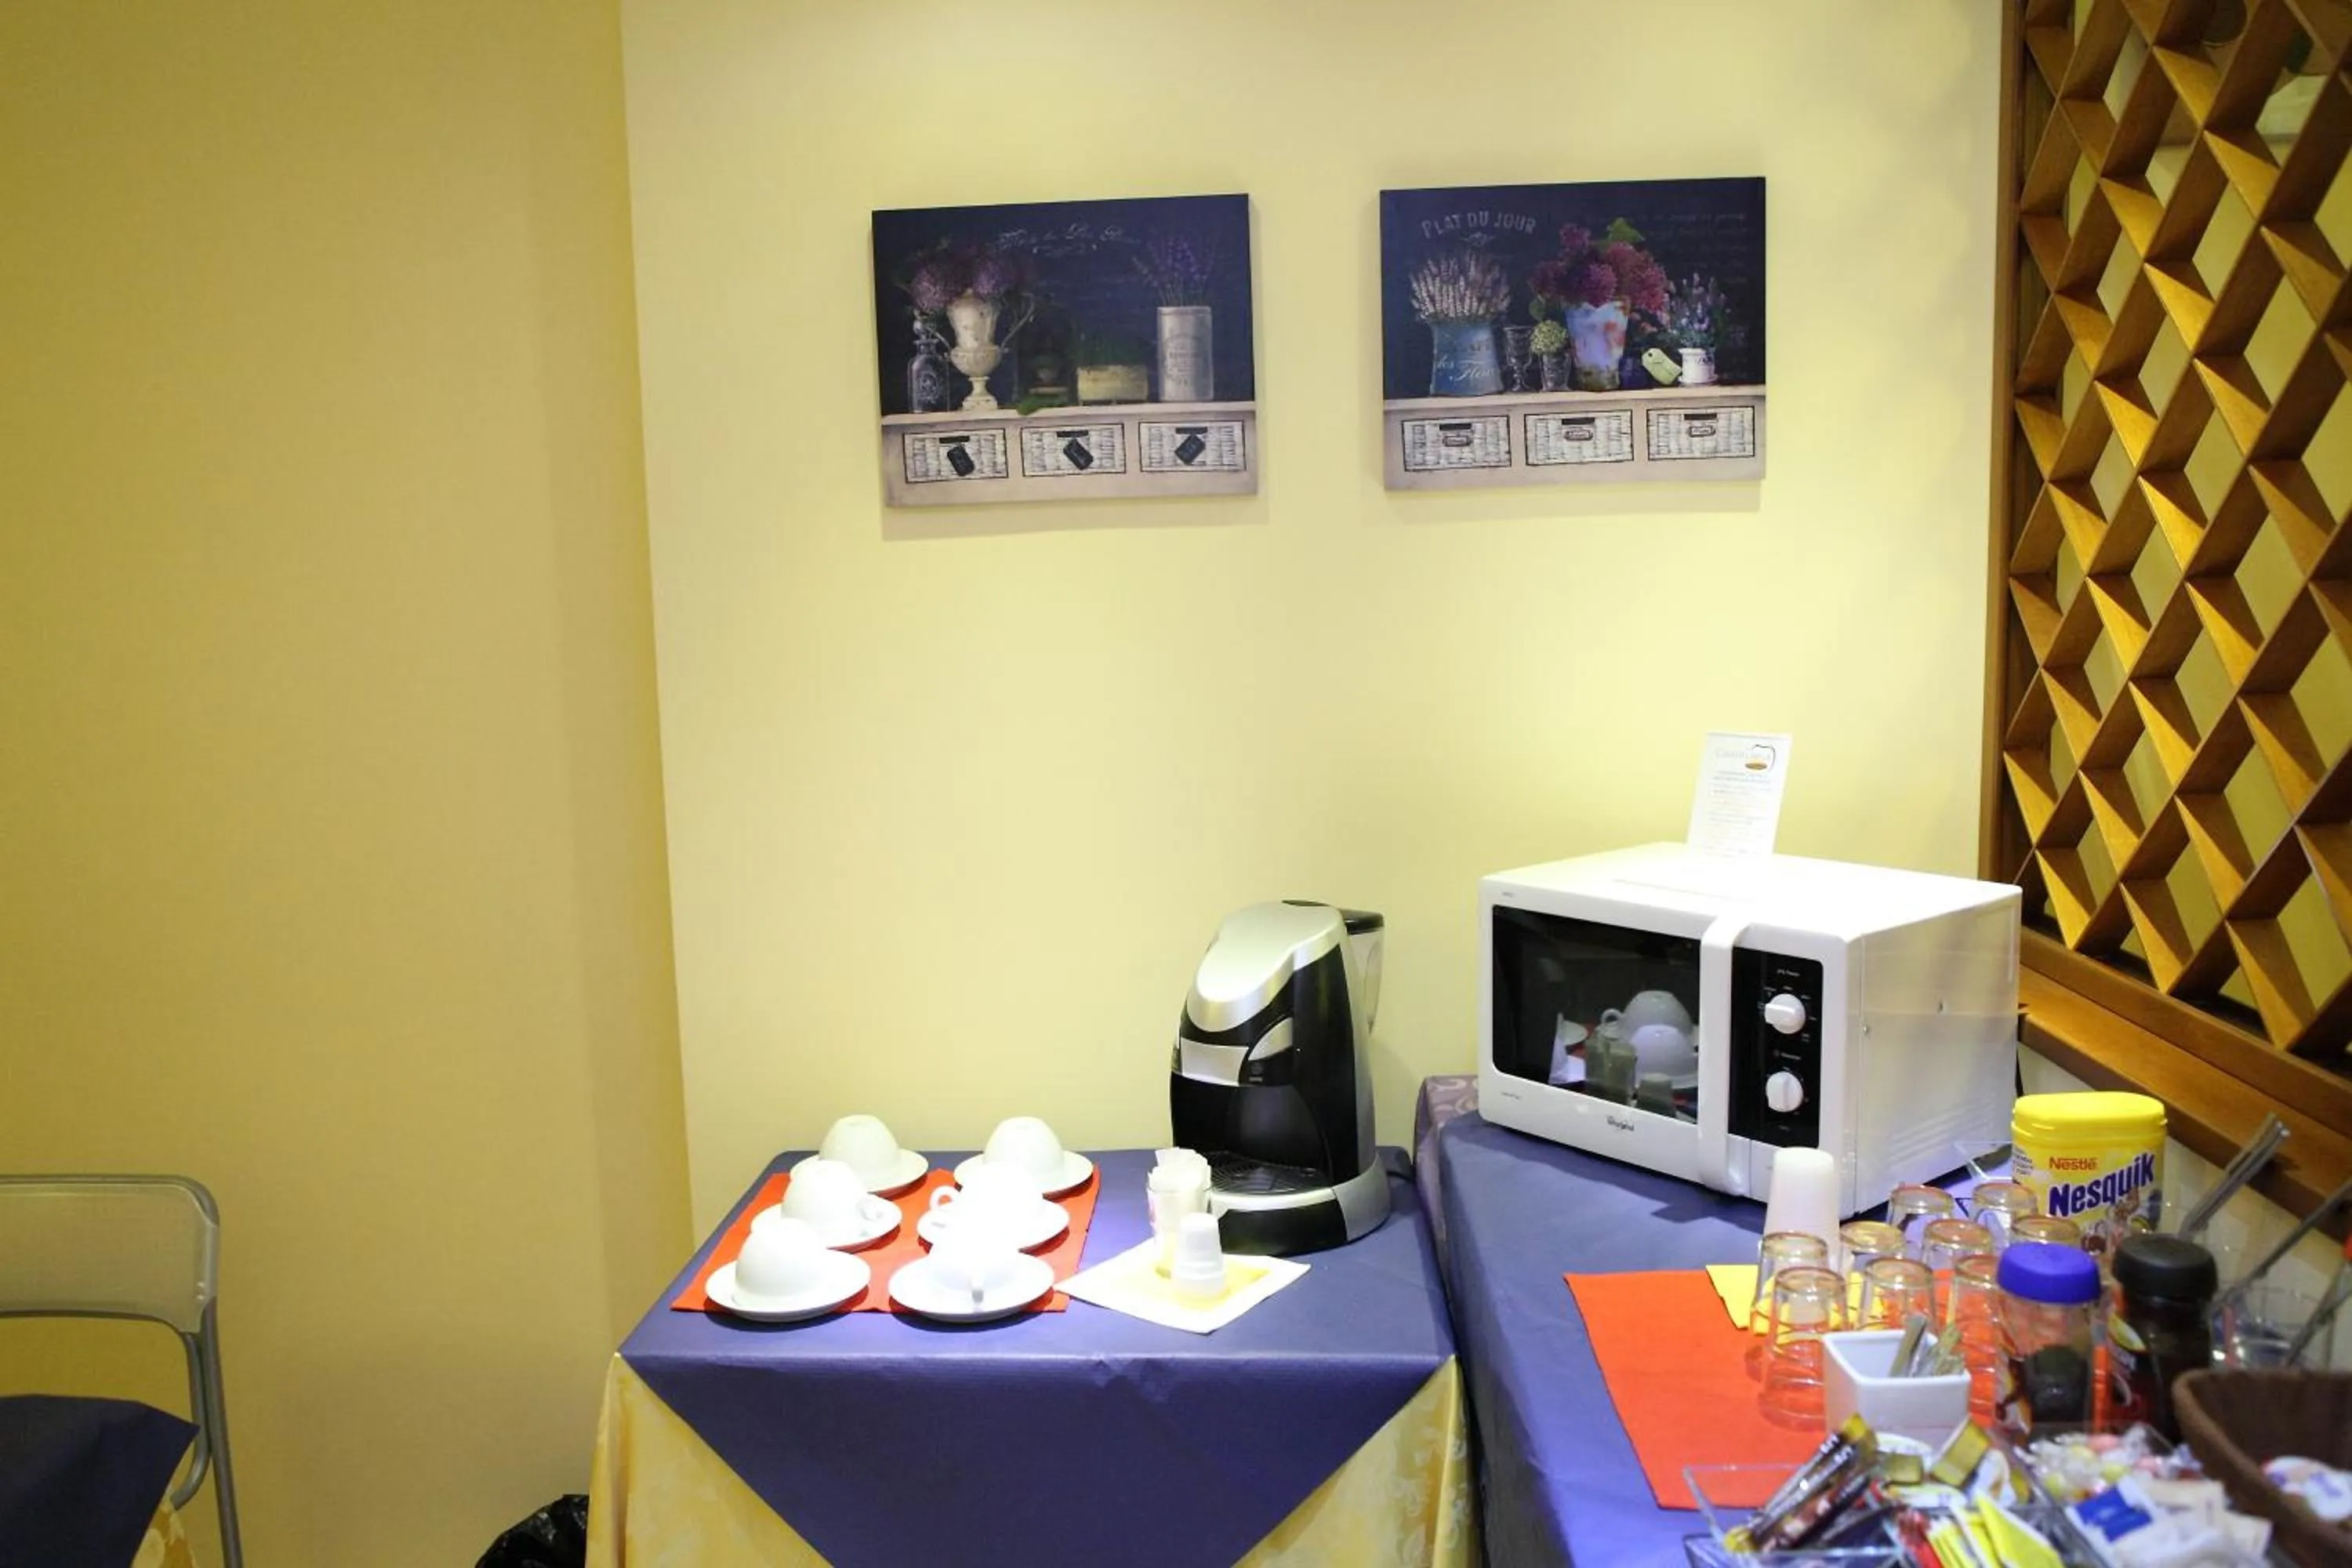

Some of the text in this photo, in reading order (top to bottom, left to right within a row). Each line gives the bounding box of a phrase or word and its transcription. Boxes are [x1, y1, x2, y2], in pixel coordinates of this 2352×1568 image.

[1421, 210, 1537, 239] PLAT DU JOUR
[2049, 1152, 2156, 1218] Nesquik
